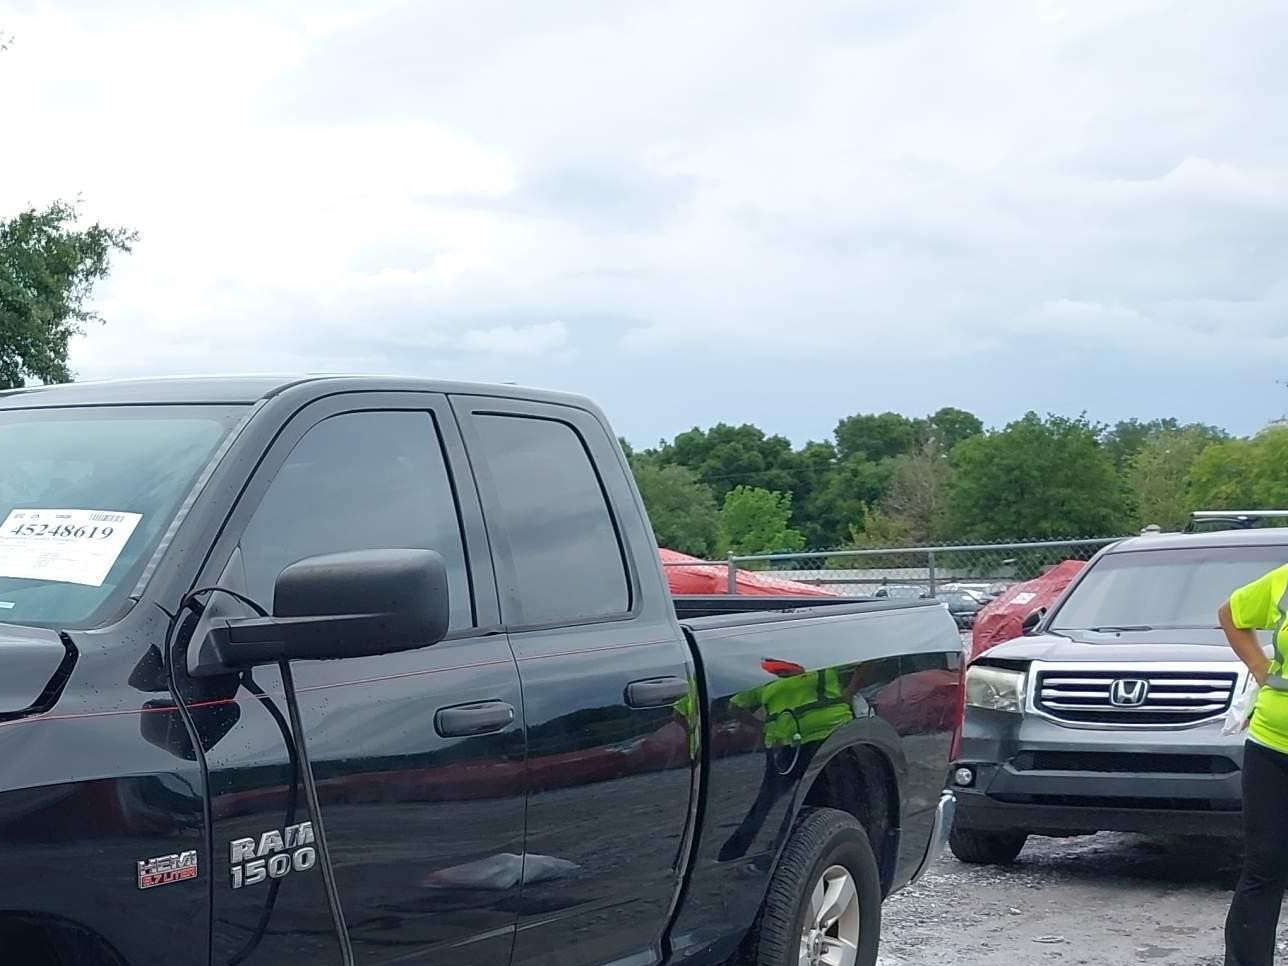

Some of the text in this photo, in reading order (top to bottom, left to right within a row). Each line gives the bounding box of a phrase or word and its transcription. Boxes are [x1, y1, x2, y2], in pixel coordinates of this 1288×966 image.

[10, 523, 114, 540] 45248619
[229, 821, 315, 864] RAM
[137, 850, 197, 875] HEMI
[231, 846, 316, 889] 1500
[142, 867, 195, 887] 5.7 LITER
